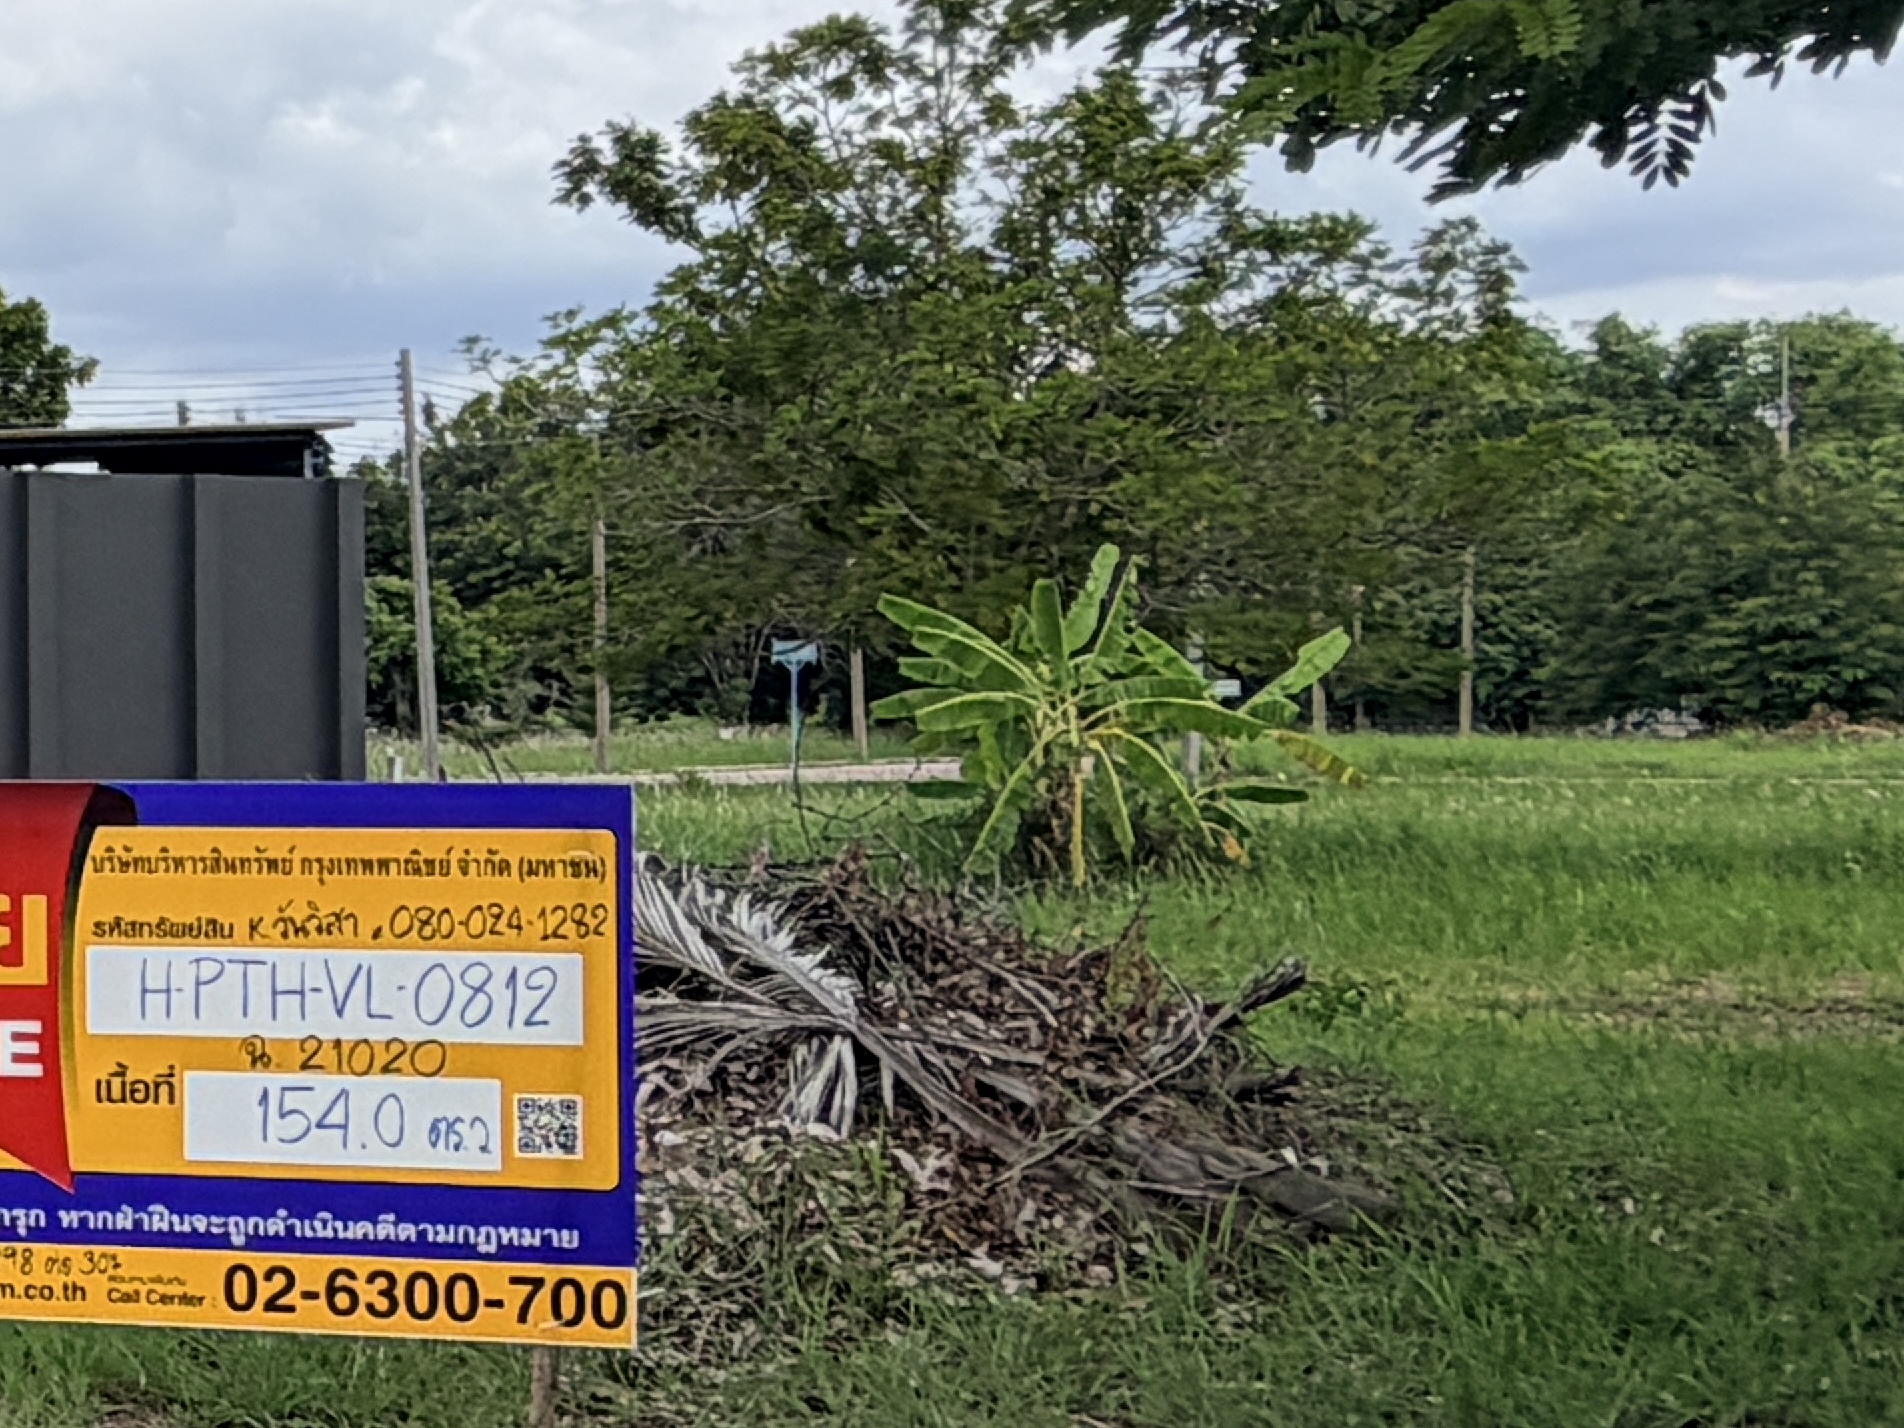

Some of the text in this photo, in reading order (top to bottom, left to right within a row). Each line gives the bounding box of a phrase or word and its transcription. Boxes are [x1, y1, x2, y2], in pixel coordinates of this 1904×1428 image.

[457, 847, 511, 878] จำกัด
[298, 1035, 447, 1077] 21020
[95, 1061, 176, 1105] เนื้อที่
[257, 1086, 405, 1150] 154.0
[223, 1263, 629, 1330] 02-6300-700
